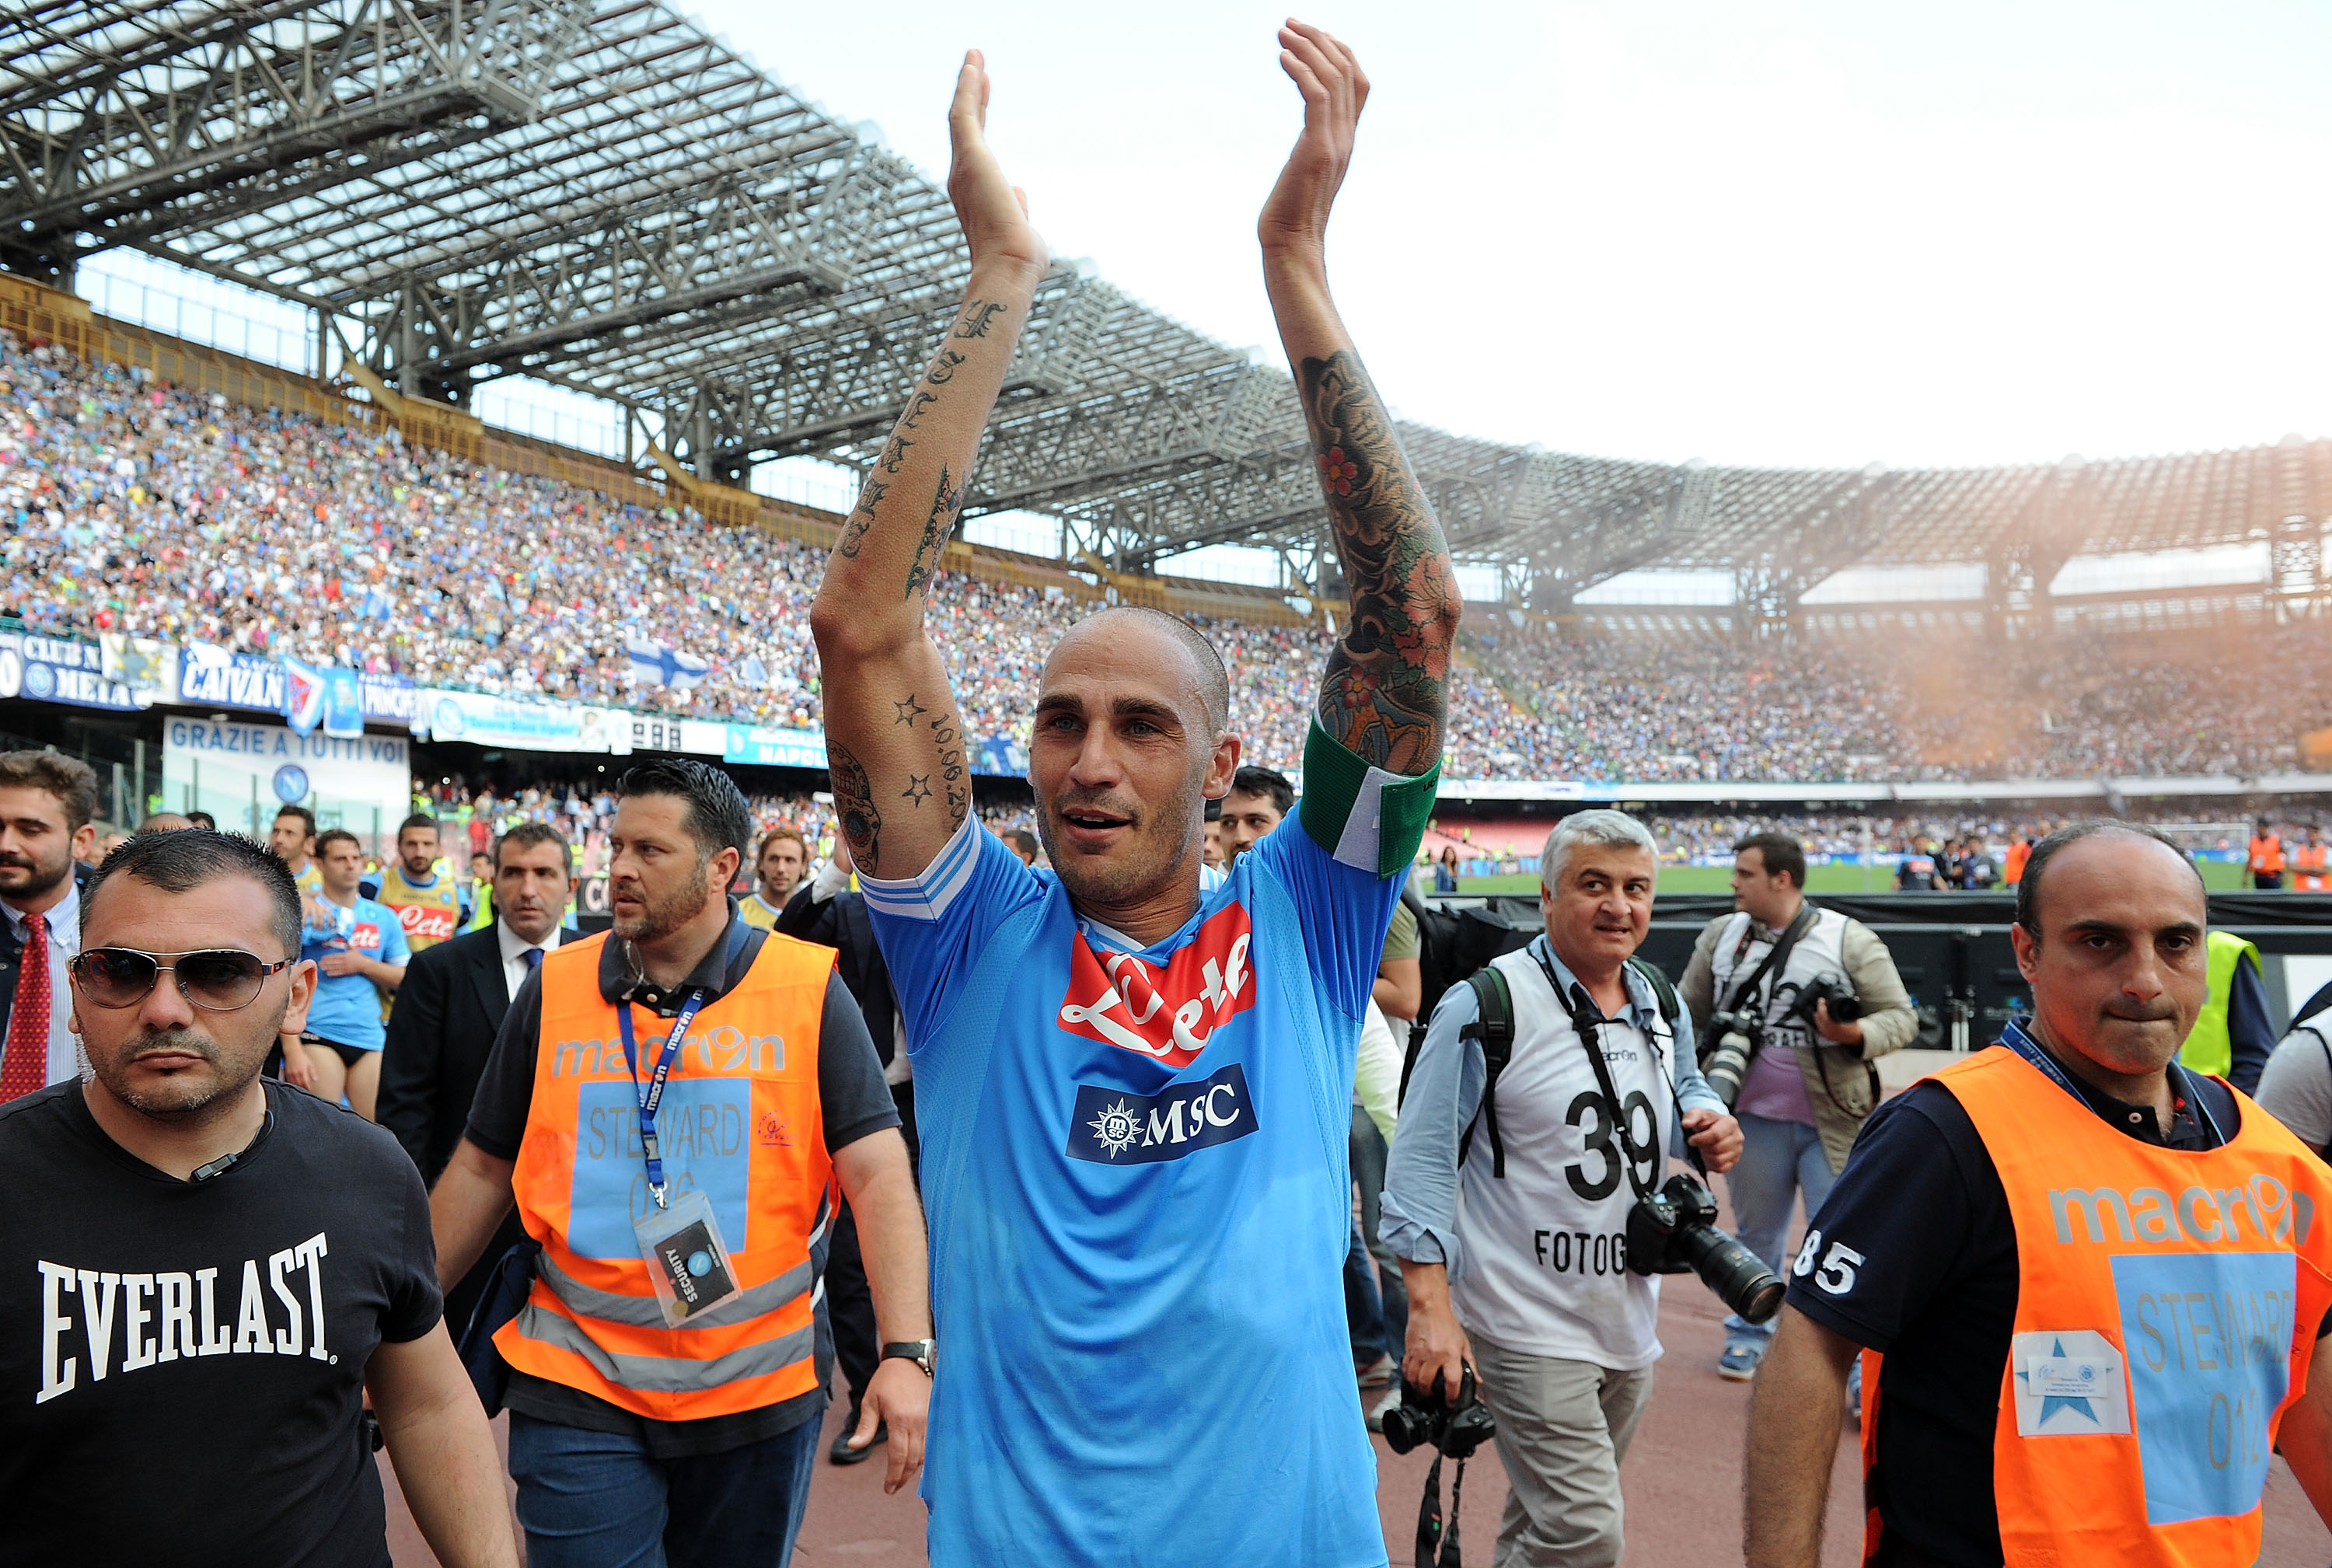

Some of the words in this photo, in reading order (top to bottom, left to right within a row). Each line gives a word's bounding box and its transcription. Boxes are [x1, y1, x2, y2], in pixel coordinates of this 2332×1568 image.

[23, 634, 82, 667] CLUB
[172, 721, 265, 754] GRAZIE
[274, 725, 288, 755] A
[297, 735, 363, 761] TUTTI
[369, 739, 404, 763] VOI
[1061, 932, 1251, 1056] Lete
[552, 1025, 785, 1077] macron
[667, 1011, 693, 1051] macron
[1601, 1049, 1637, 1062] acron
[647, 1064, 668, 1112] macron
[1141, 1083, 1240, 1147] MSC
[588, 1102, 742, 1161] STEWARD
[1565, 1090, 1660, 1201] 39
[2047, 1172, 2315, 1247] macron
[665, 1248, 699, 1304] SECURITY
[1793, 1229, 1866, 1295] 85
[36, 1231, 328, 1405] EVERLAST
